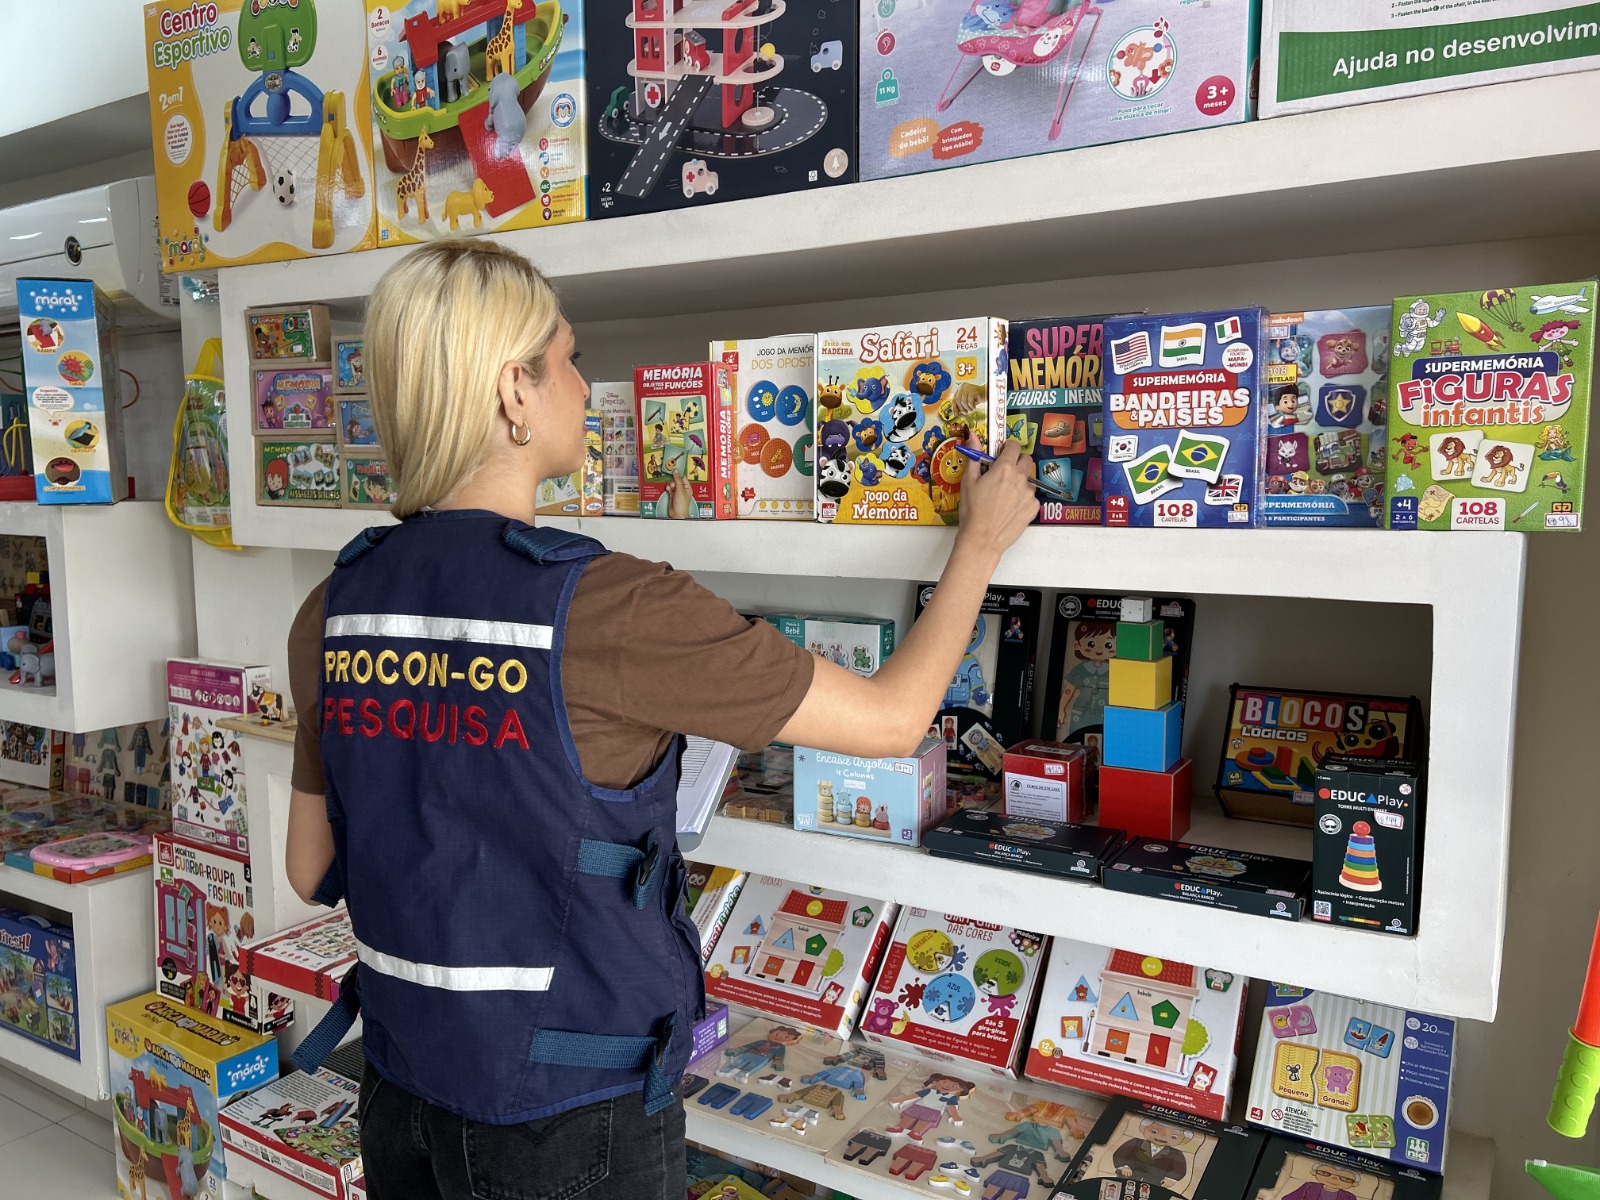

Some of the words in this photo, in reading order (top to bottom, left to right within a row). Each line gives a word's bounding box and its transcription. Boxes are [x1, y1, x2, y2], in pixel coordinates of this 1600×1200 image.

[160, 2, 218, 38] Centro
[377, 9, 383, 19] 2
[153, 26, 231, 69] Esportivo
[377, 46, 382, 56] 6
[1332, 51, 1398, 79] Ajuda
[1405, 46, 1435, 65] no
[1442, 21, 1600, 60] desenvolvim
[879, 86, 887, 94] 11
[887, 85, 896, 95] Kg
[1132, 105, 1147, 113] para
[1147, 103, 1164, 111] tocar
[1203, 100, 1228, 109] meses
[1123, 112, 1143, 121] música
[1153, 108, 1172, 117] ninar!
[900, 126, 927, 139] Cadeira
[941, 131, 973, 144] brinquedos
[899, 141, 908, 149] do
[909, 136, 930, 147] bebê!
[953, 139, 974, 150] móbile!
[602, 182, 611, 192] +2
[957, 326, 978, 343] 24
[860, 327, 940, 363] Safári
[956, 342, 978, 350] PEÇAS
[1026, 323, 1104, 360] SUPER
[756, 348, 775, 356] JOGO
[777, 347, 787, 355] DA
[787, 344, 814, 355] MEMÓR
[821, 347, 853, 355] MADEIRA
[751, 358, 774, 370] DOS
[777, 356, 814, 369] OPOST
[957, 362, 975, 375] 3+
[1010, 345, 1104, 390] MEMÓR
[1424, 356, 1545, 374] SUPERMEMÓRIA
[643, 366, 703, 381] MEMÓRIA
[1268, 366, 1288, 375] 108
[664, 379, 704, 390] FUNÇÕES
[1132, 371, 1227, 387] SUPERMEMÓRIA
[1006, 391, 1057, 406] FIGURAS
[1109, 388, 1251, 412] BANDEIRAS
[1422, 400, 1545, 427] infantis
[862, 490, 889, 503] Jogo
[893, 489, 908, 501] da
[1150, 484, 1165, 495] BRASIL
[643, 503, 653, 511] +4
[1110, 497, 1125, 507] +4
[1396, 499, 1412, 510] +4
[1458, 501, 1498, 516] 108
[852, 500, 918, 520] Memória
[1043, 502, 1063, 521] 108
[1065, 508, 1101, 520] CARTELAS
[1157, 503, 1194, 517] 108
[1456, 516, 1500, 525] CARTELAS
[785, 625, 800, 635] Bebê
[324, 648, 528, 694] PROCON-GO
[1244, 695, 1366, 732] BLOCOS
[322, 697, 531, 750] PESQUISA
[1241, 725, 1308, 742] LÓGICOS
[816, 752, 852, 766] Encaixe
[852, 756, 895, 773] Argolas
[843, 769, 875, 780] Colunas
[1229, 772, 1240, 780] 48
[174, 855, 236, 888] GUARDA-ROUPA
[207, 882, 244, 909] FASHION
[1181, 891, 1201, 899] BALANÇA
[1345, 900, 1376, 908] Interpretação
[946, 924, 963, 936] DAS
[965, 928, 994, 941] CORES
[1015, 930, 1041, 942] madeira
[911, 932, 935, 952] AMARELO
[994, 957, 1012, 968] VERDE
[946, 982, 963, 993] AZUL
[984, 1018, 997, 1027] São
[1421, 1022, 1438, 1034] 20
[971, 1030, 987, 1038] para
[986, 1033, 1009, 1043] brincar
[977, 1025, 1007, 1036] gira-giras
[319, 1070, 359, 1095] FAZENDI
[1278, 1085, 1309, 1098] Pequeno
[1322, 1095, 1350, 1107] Grande
[1284, 1106, 1309, 1117] ATENÇÃO:
[209, 1177, 217, 1186] 22
